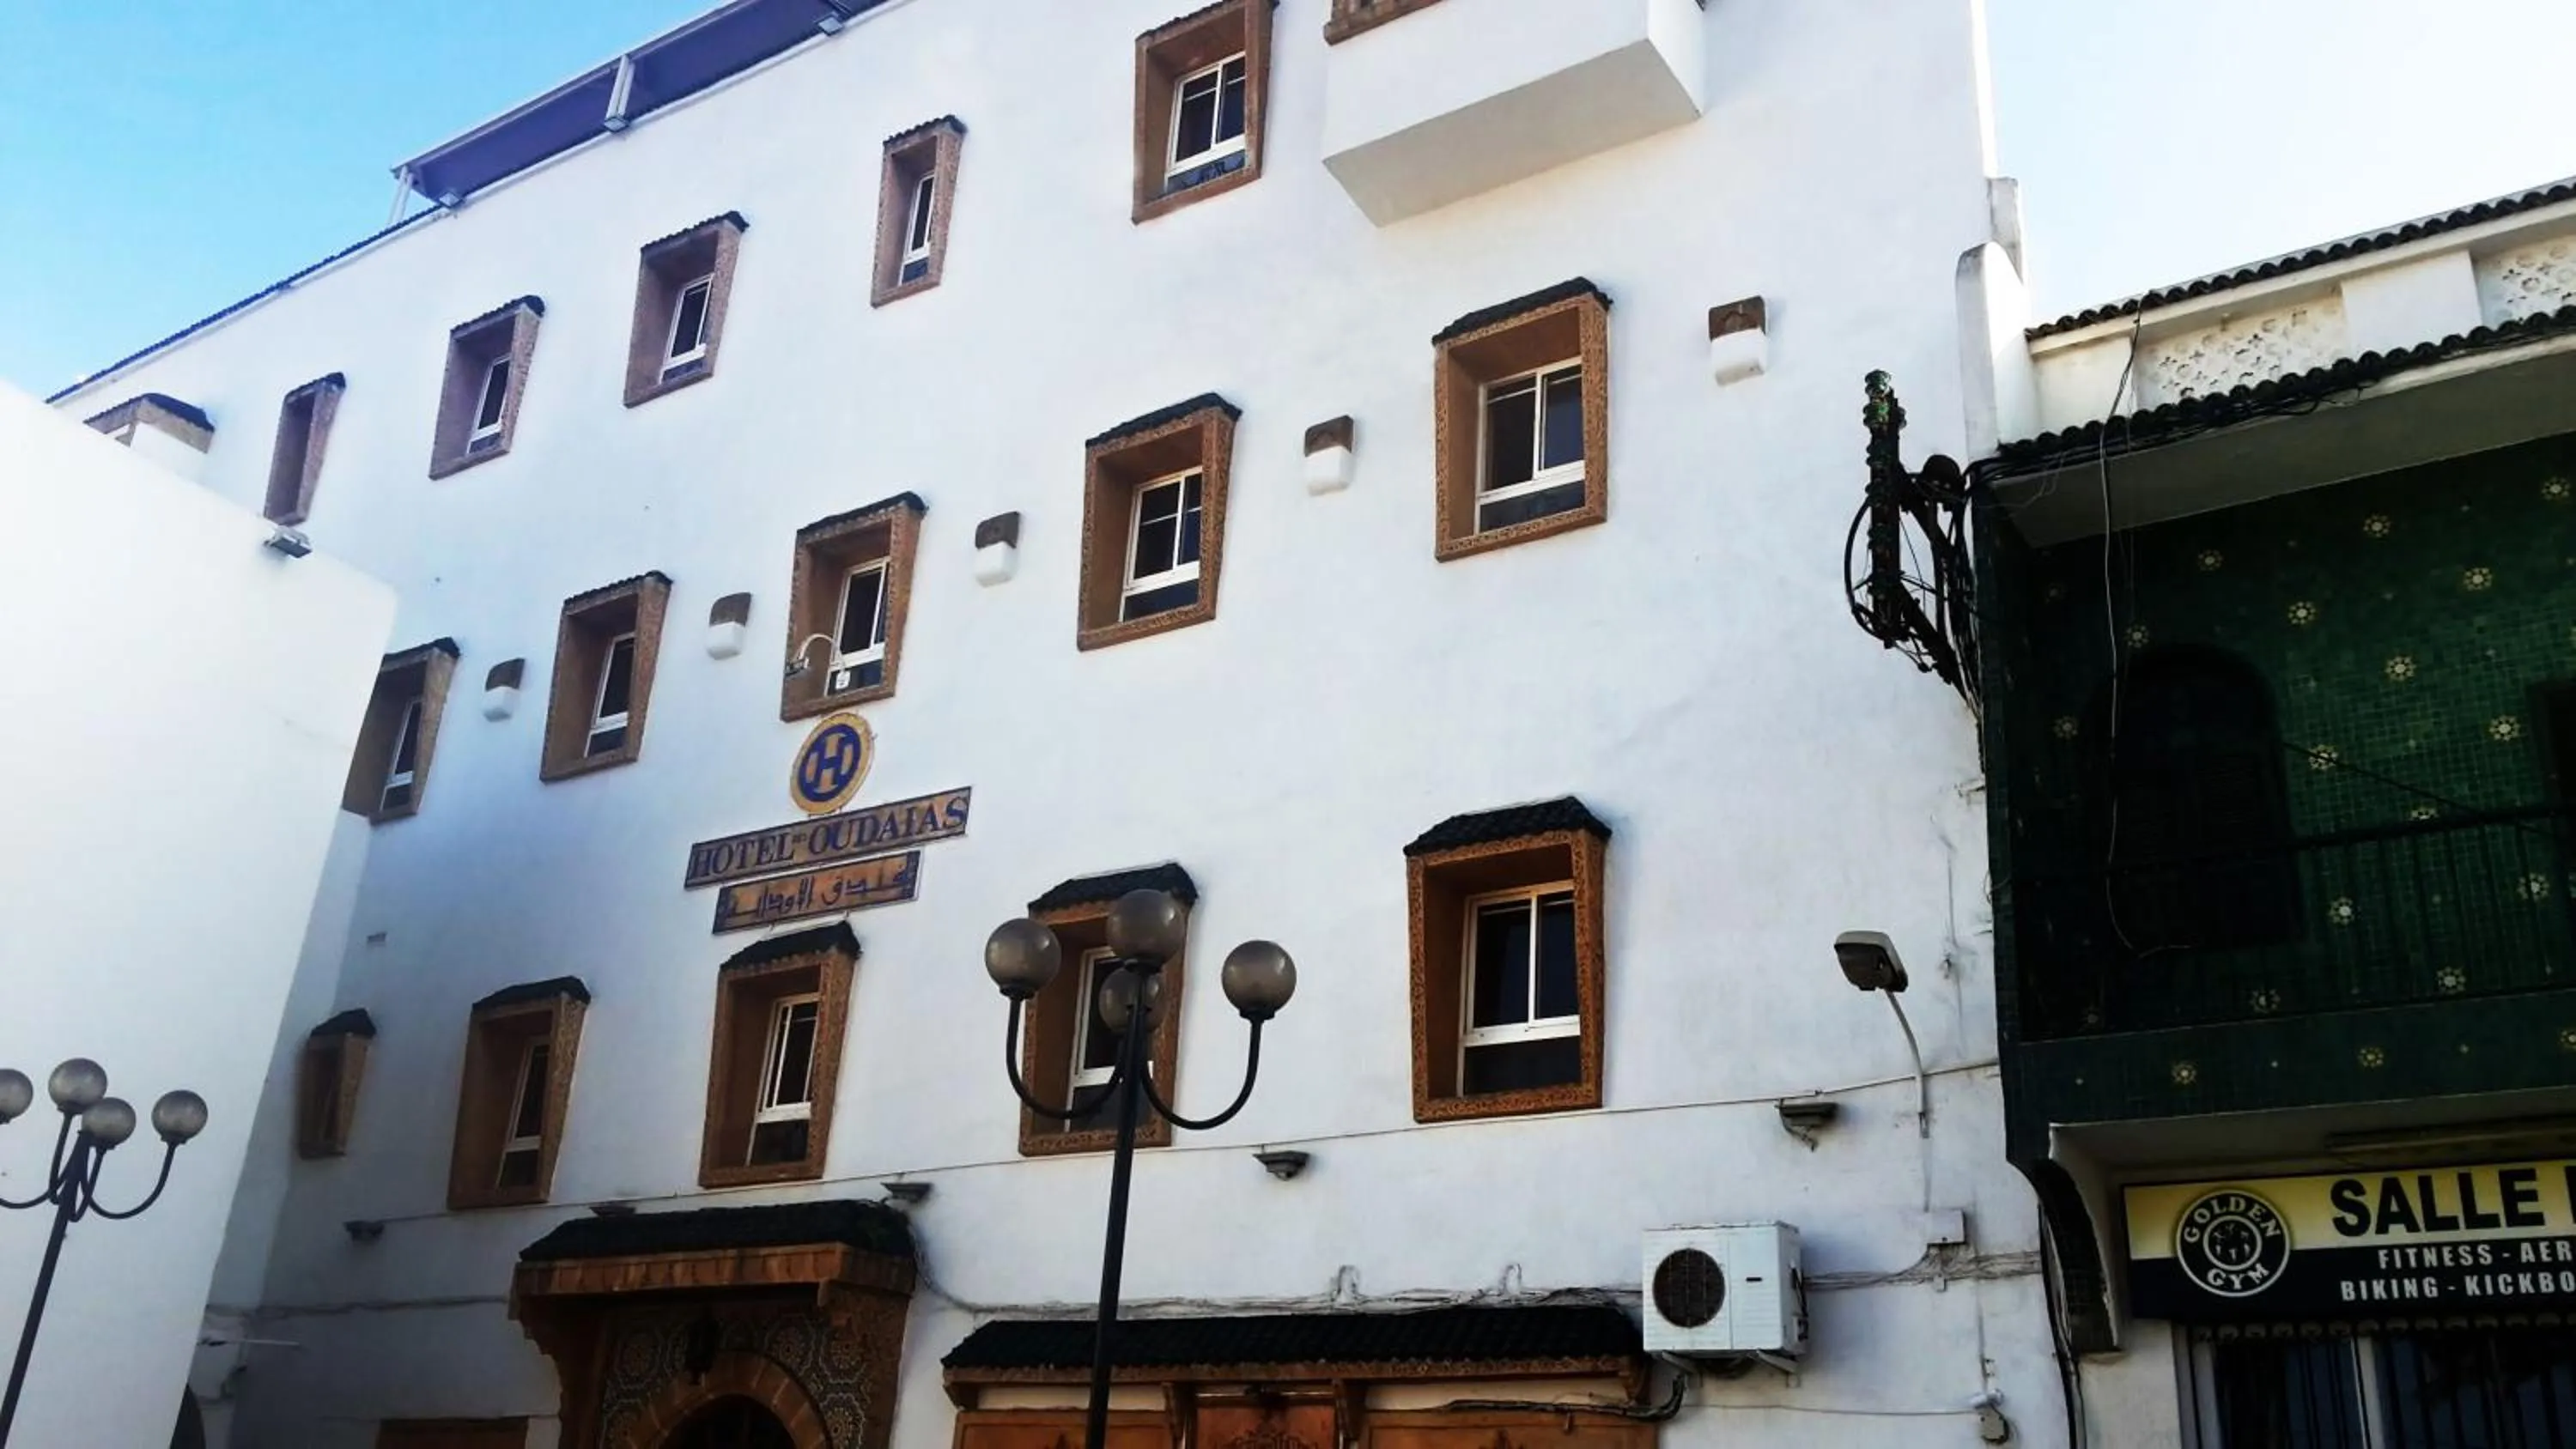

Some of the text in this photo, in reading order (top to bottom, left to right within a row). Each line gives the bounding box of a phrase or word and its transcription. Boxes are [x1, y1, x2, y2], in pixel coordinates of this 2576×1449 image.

[693, 833, 794, 877] HOTEL
[808, 796, 969, 855] OUDAIAS
[2184, 1196, 2281, 1243] GOLDEN
[2330, 1168, 2545, 1237] SALLE
[2378, 1244, 2493, 1270] FITNESS
[2520, 1240, 2573, 1263] AER
[2207, 1263, 2269, 1289] GYM
[2341, 1276, 2439, 1301] BIKING
[2464, 1270, 2576, 1296] KICKBO
